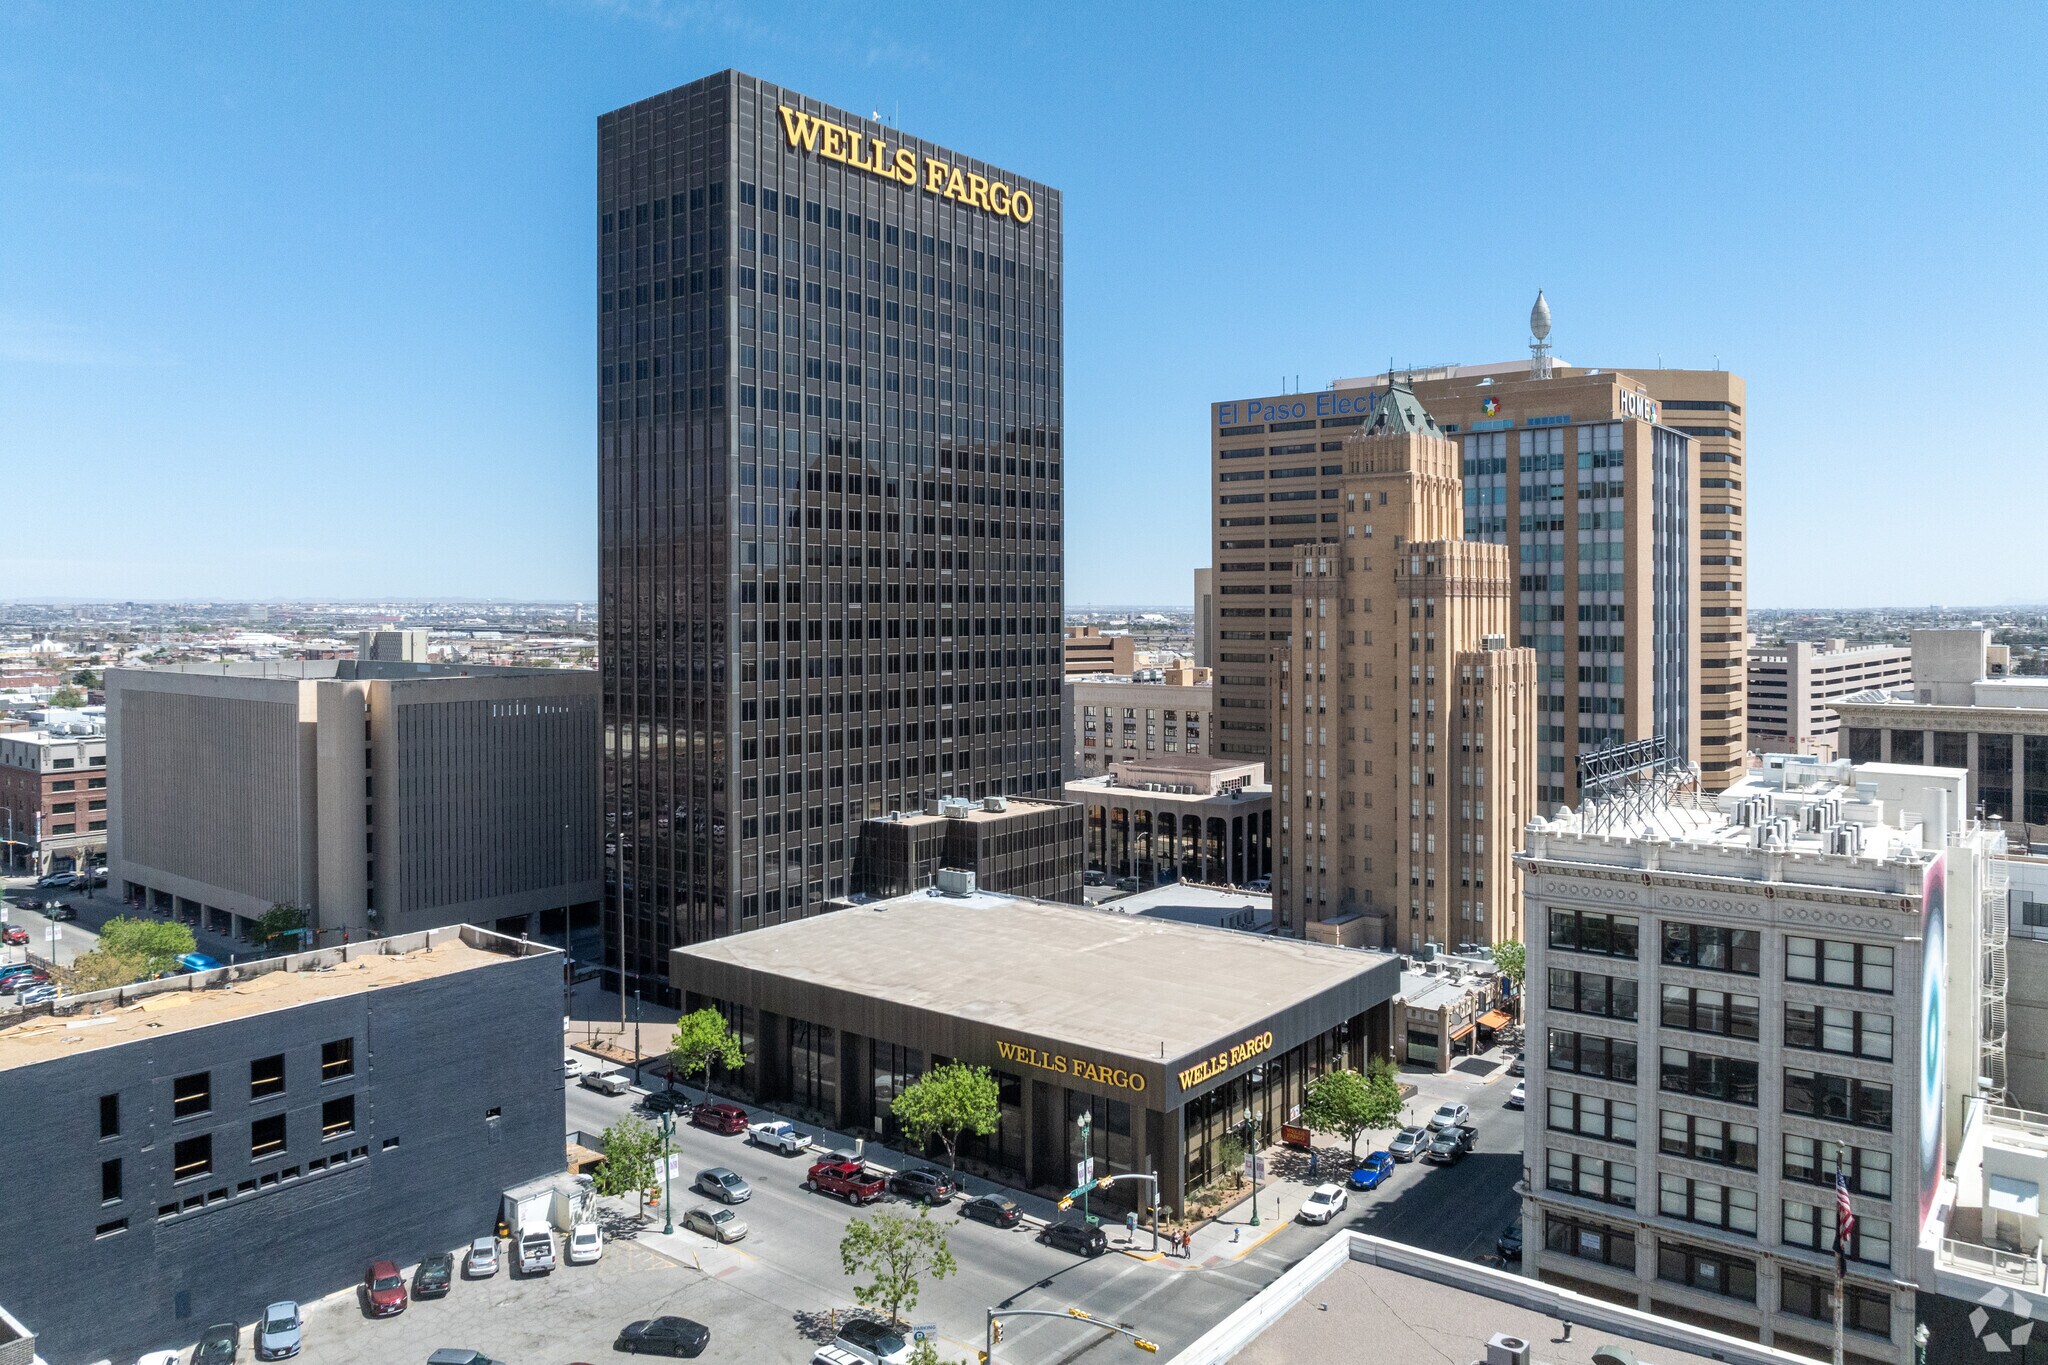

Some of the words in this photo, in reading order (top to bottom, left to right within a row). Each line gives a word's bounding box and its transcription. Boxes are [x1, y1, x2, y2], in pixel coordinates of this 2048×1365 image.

[779, 105, 917, 186] WELLS
[924, 157, 1034, 223] FARGO
[1218, 402, 1238, 426] El
[1247, 401, 1306, 423] Paso
[1316, 391, 1383, 417] Elect
[1621, 389, 1650, 420] HOME
[996, 1041, 1067, 1073] WELLS
[1072, 1059, 1146, 1092] FARGO
[1178, 1052, 1227, 1091] WELLS
[1229, 1031, 1273, 1067] FARGO
